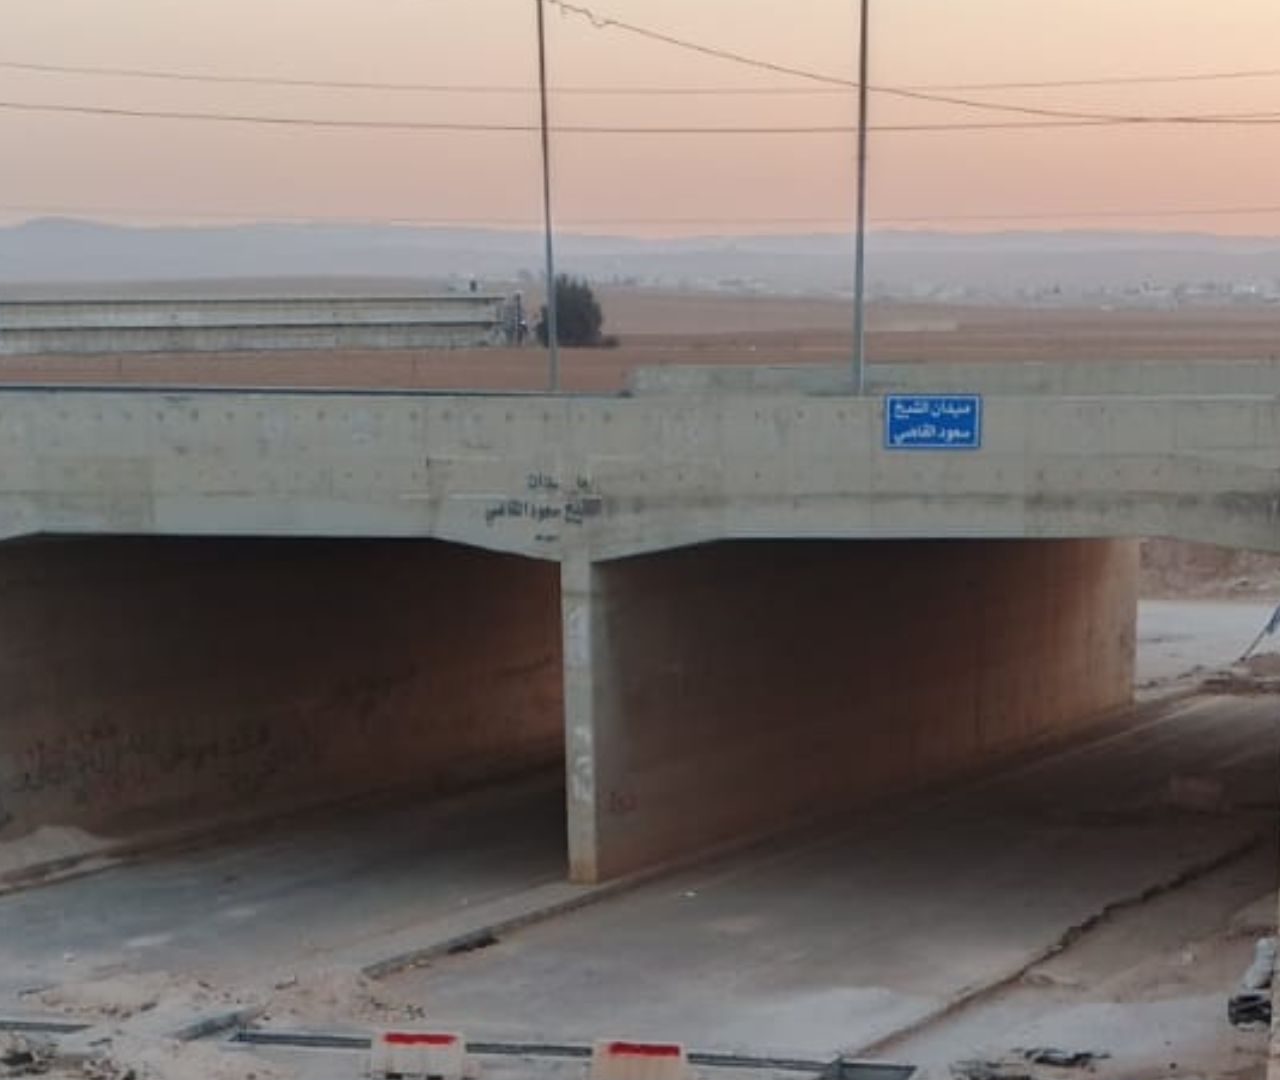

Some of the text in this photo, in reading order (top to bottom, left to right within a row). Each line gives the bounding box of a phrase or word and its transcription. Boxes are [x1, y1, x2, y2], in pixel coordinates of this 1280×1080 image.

[894, 401, 970, 420] ميدان الشيخ
[894, 424, 970, 444] سعود القاضي
